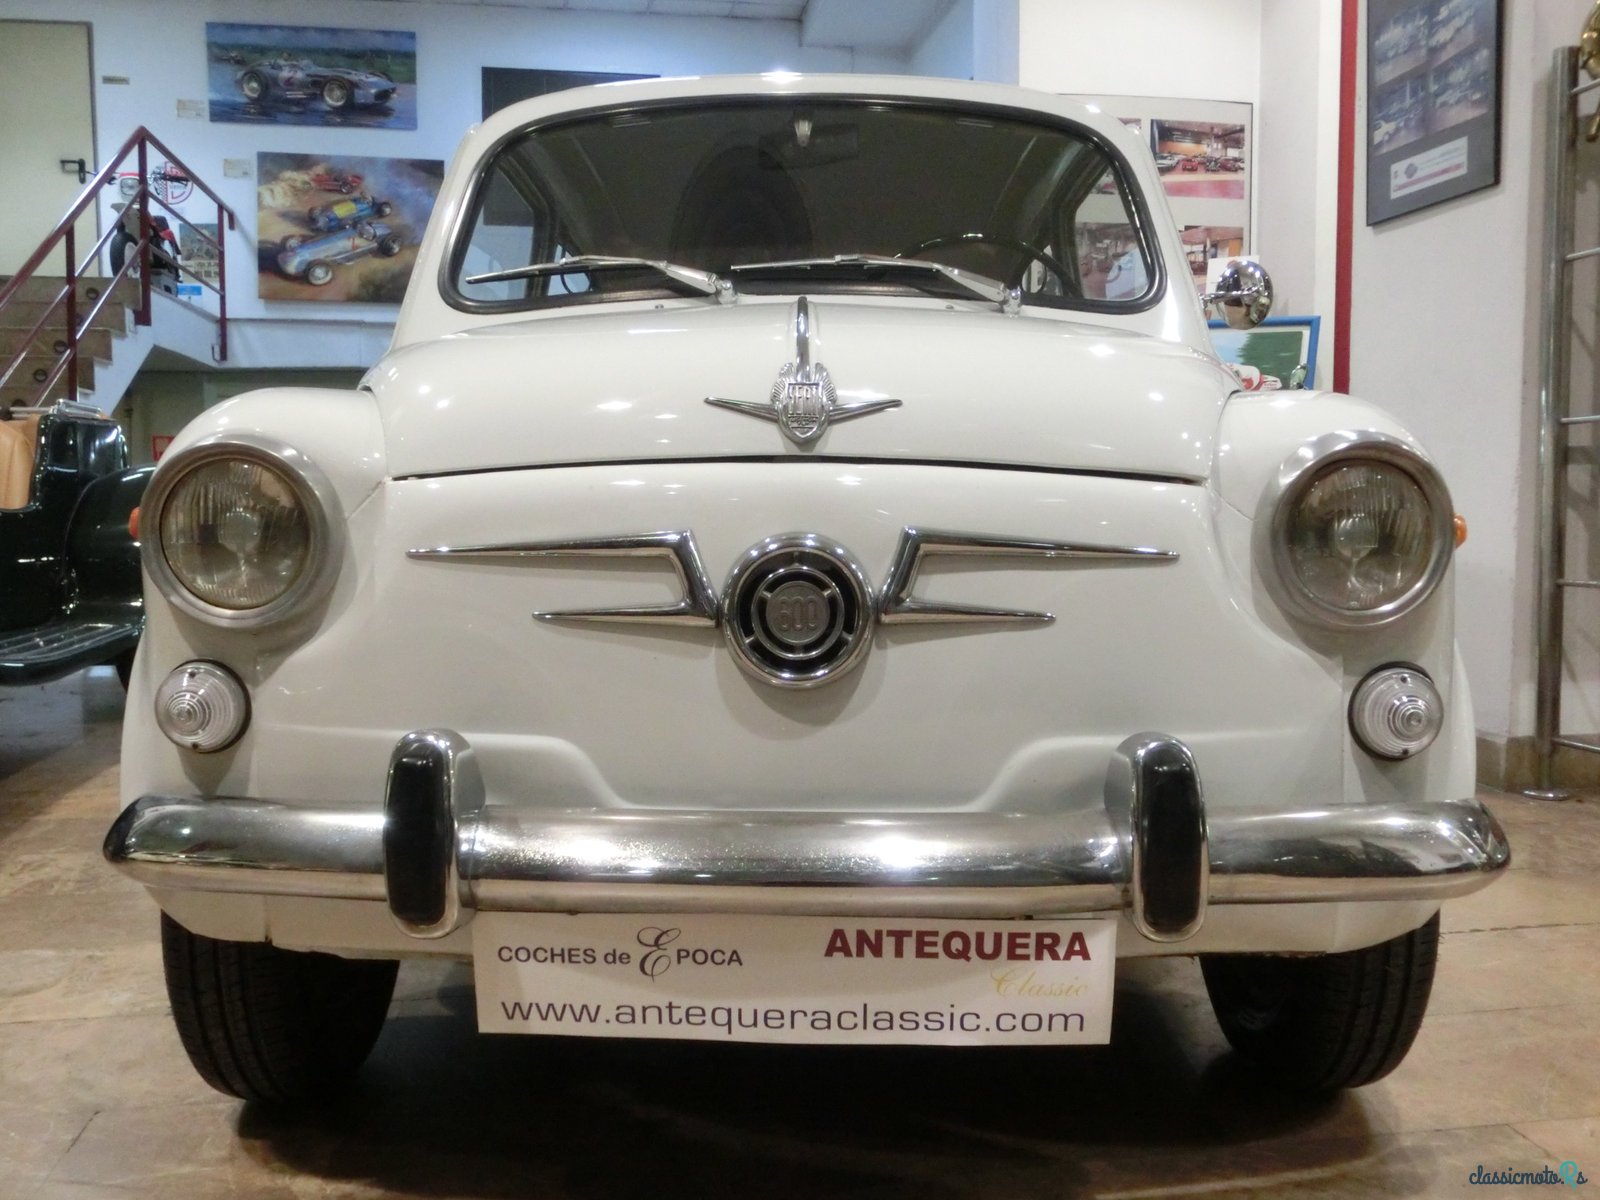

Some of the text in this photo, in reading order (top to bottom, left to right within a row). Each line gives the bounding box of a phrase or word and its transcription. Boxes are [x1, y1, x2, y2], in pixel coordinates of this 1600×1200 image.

[778, 596, 819, 631] 600
[497, 946, 597, 965] COCHES
[603, 948, 632, 965] de
[824, 928, 1092, 962] ANTEQUERA
[989, 966, 1090, 998] Classic
[500, 1000, 1085, 1035] www.antequeraclassic.com
